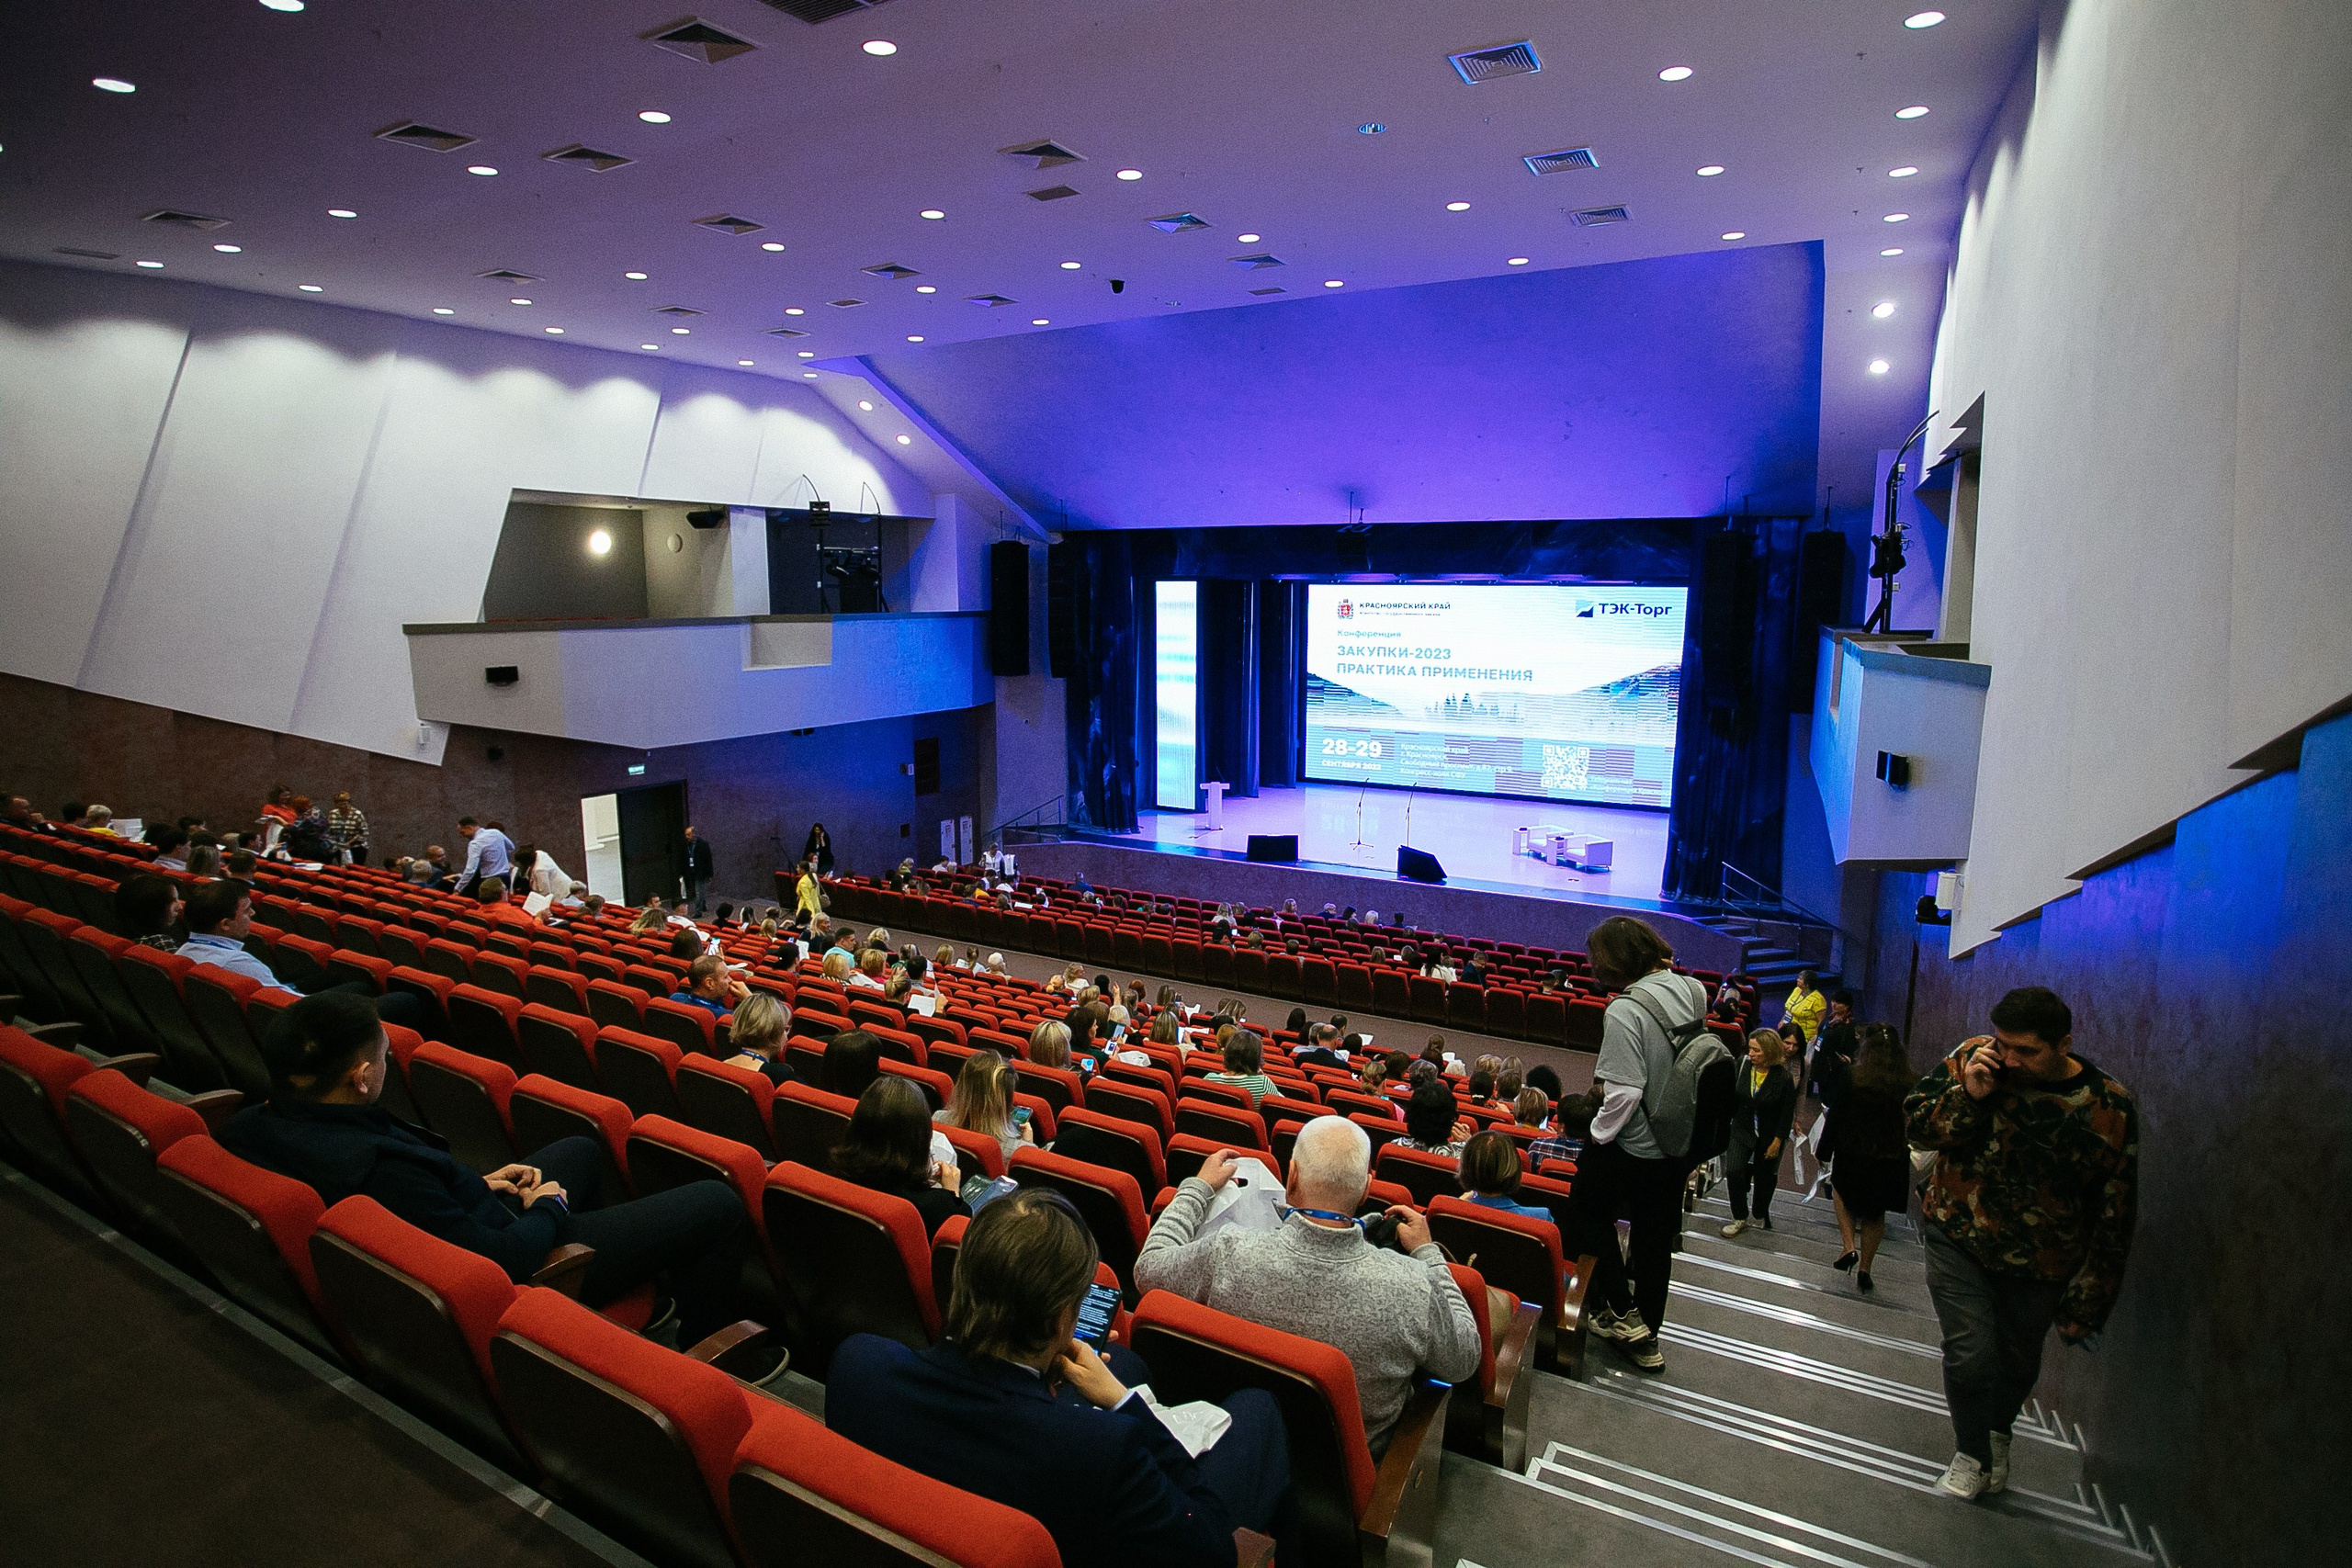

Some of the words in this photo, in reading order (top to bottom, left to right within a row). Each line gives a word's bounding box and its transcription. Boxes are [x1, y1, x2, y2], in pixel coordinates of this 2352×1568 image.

[1359, 602, 1426, 610] КРАСНОЯРСКИЙ
[1428, 602, 1451, 610] КРАЙ
[1598, 603, 1673, 618] ТЭК-Торг
[1337, 629, 1402, 638] Конференция
[1337, 645, 1452, 660] ЗАКУПКИ-2023
[1336, 662, 1418, 677] ПРАКТИКА
[1421, 666, 1533, 682] ПРИМЕНЕНИЯ
[1321, 738, 1382, 758] 28-29
